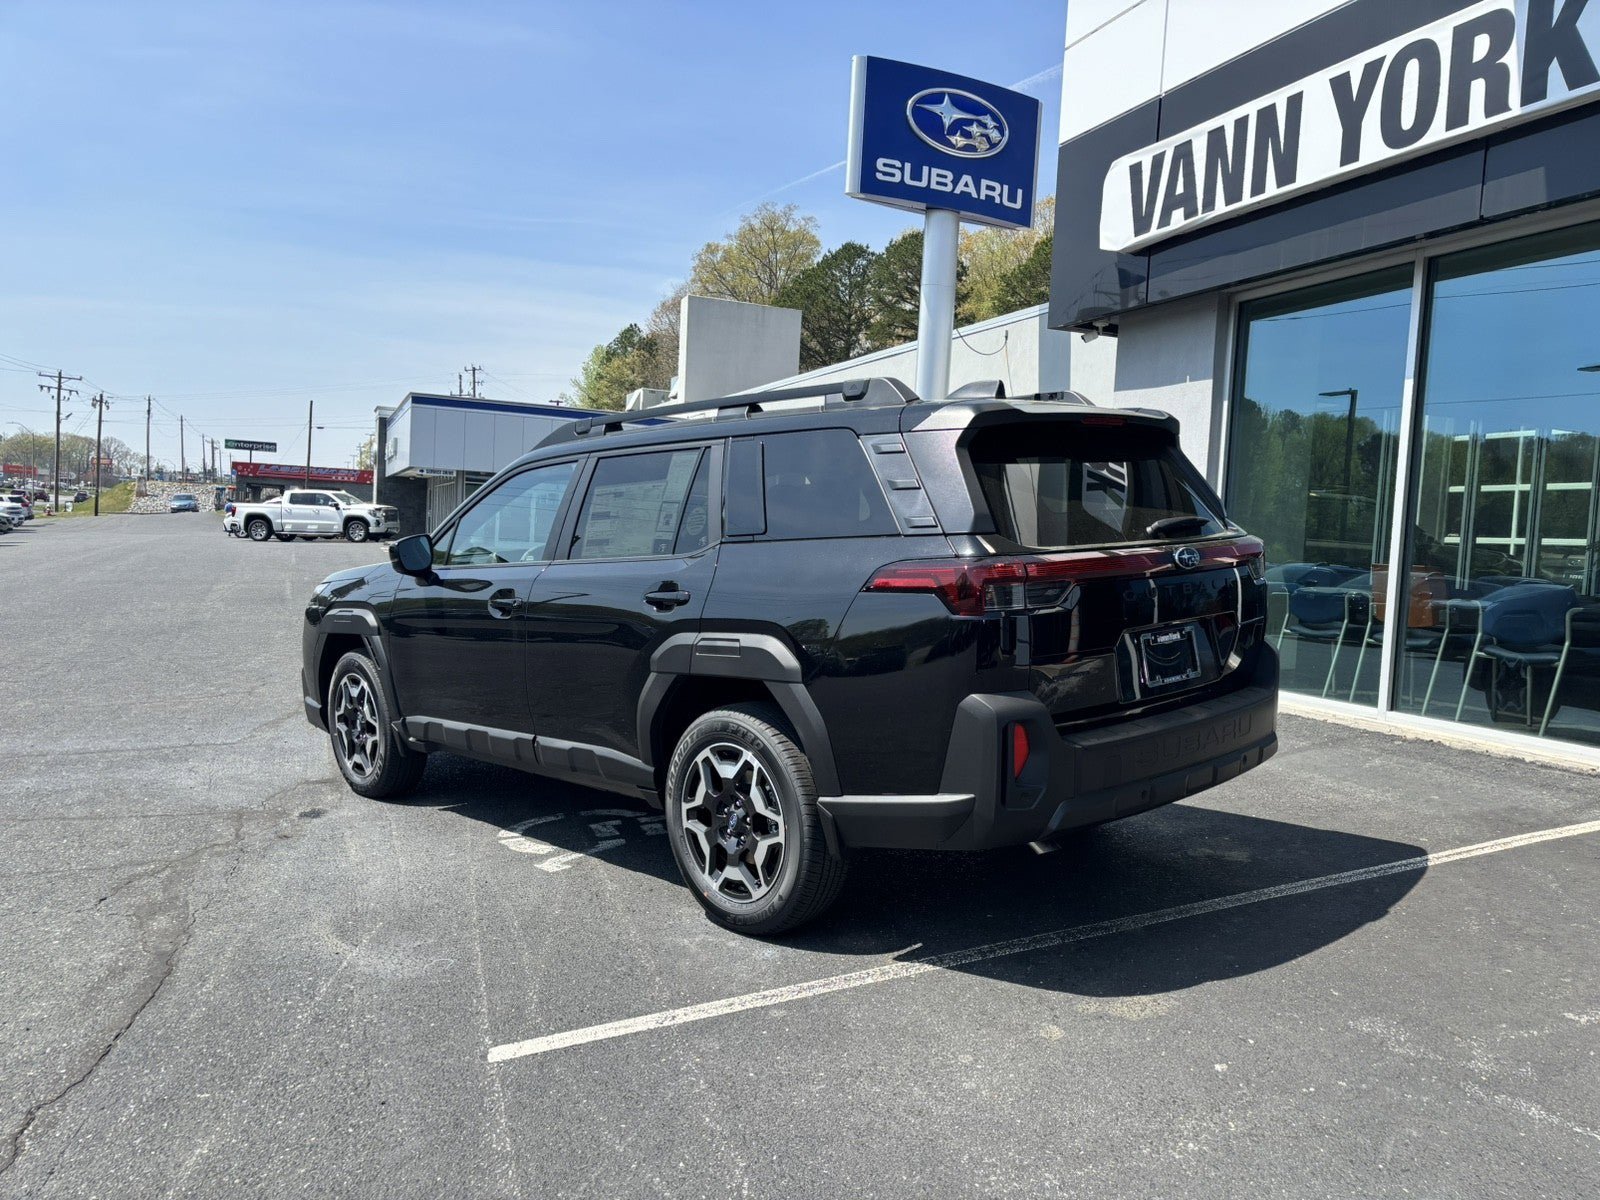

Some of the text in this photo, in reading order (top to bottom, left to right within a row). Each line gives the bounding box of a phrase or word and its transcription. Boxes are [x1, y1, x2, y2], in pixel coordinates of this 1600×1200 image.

[1128, 0, 1600, 238] VANN YORK
[875, 157, 1023, 210] SUBARU
[226, 440, 276, 449] enterprise
[1135, 713, 1253, 765] SUBARU
